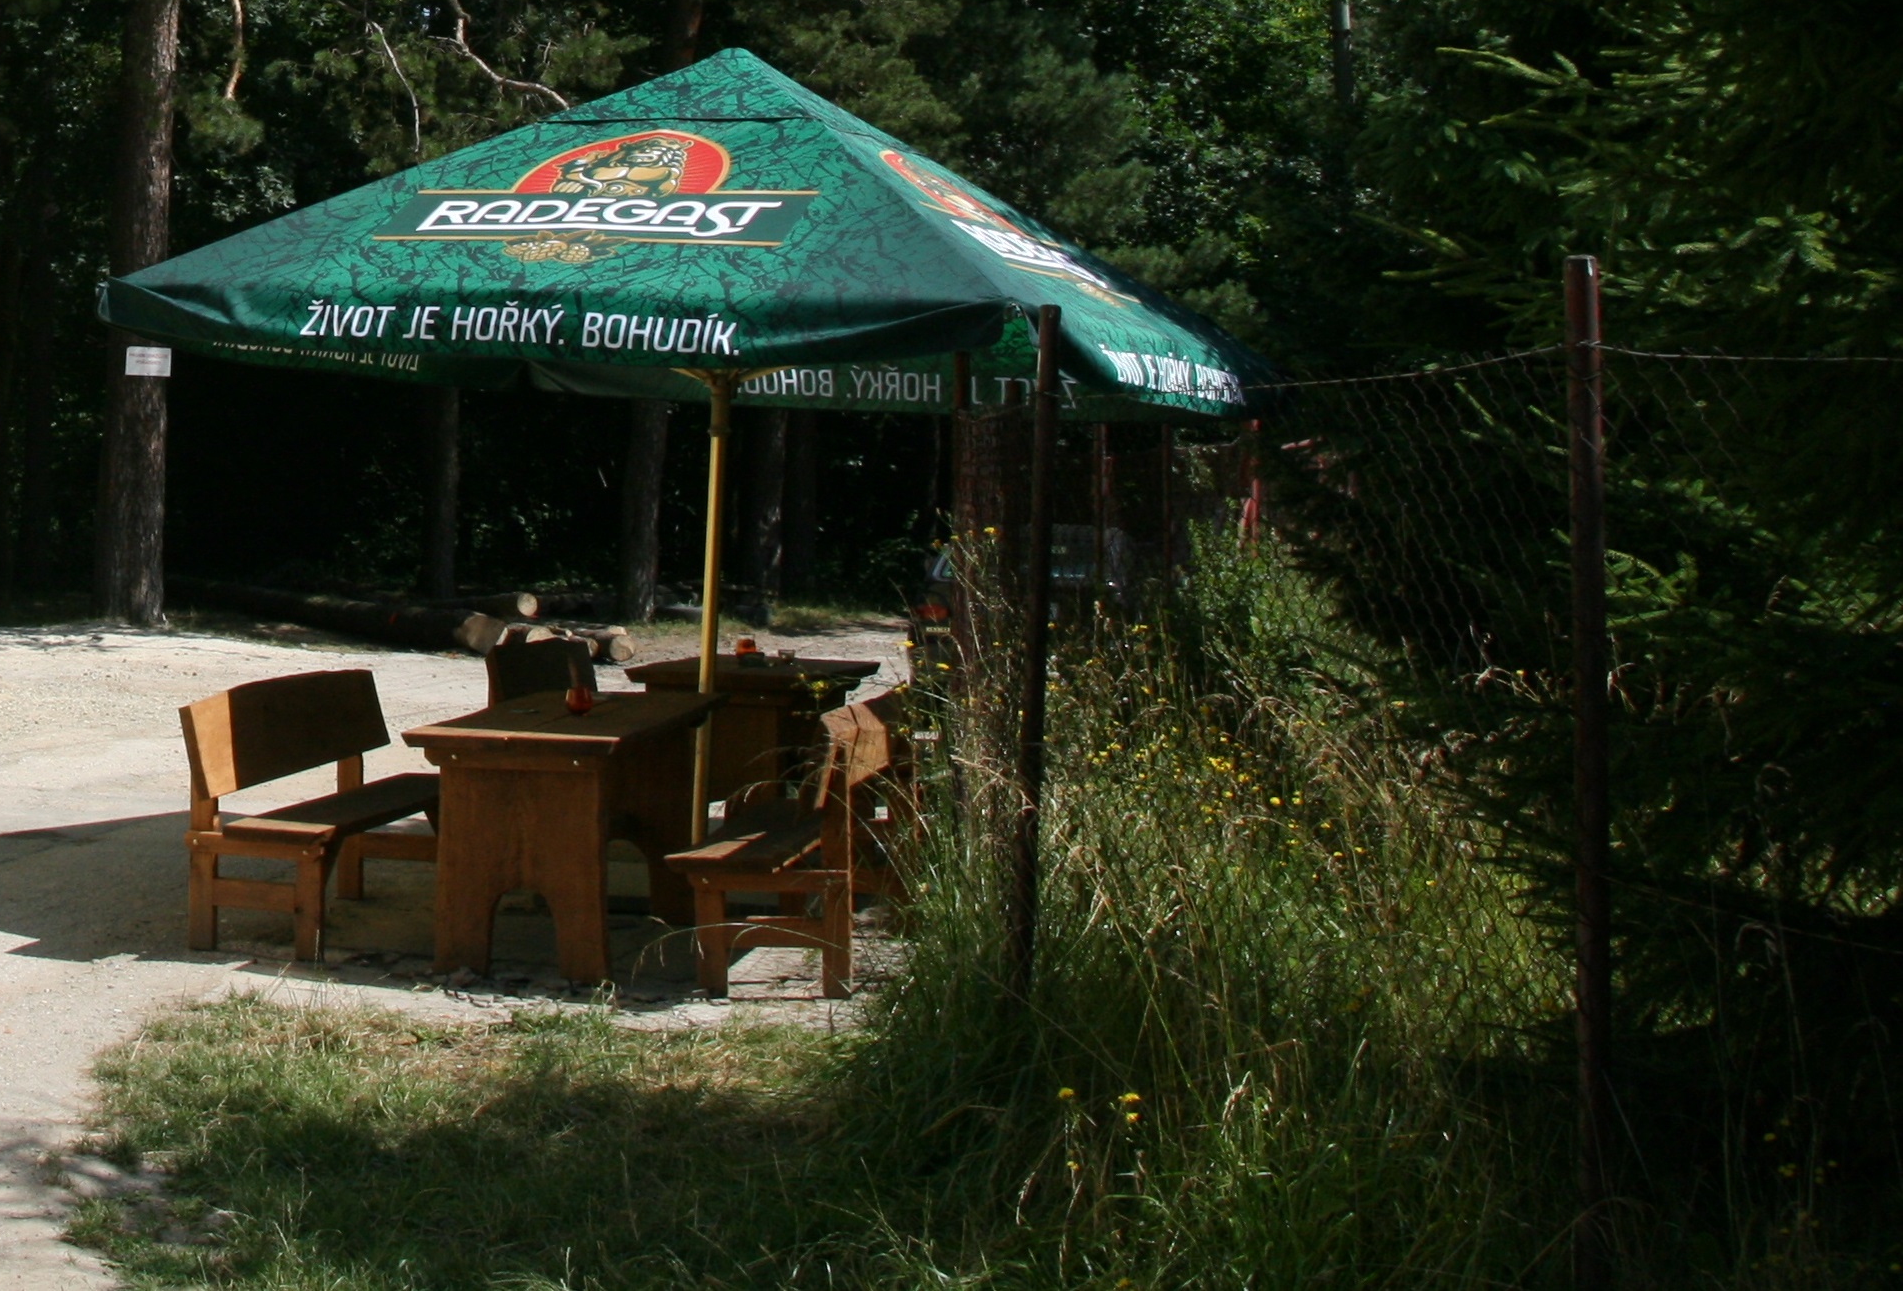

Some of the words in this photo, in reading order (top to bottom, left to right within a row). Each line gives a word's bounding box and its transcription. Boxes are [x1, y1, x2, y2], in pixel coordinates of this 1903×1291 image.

[415, 197, 783, 238] RADEGAST
[300, 299, 397, 338] ŽIVOT
[402, 305, 441, 340] JE
[450, 301, 565, 346] HOŘKÝ.
[582, 311, 741, 356] BOHUDÍK.
